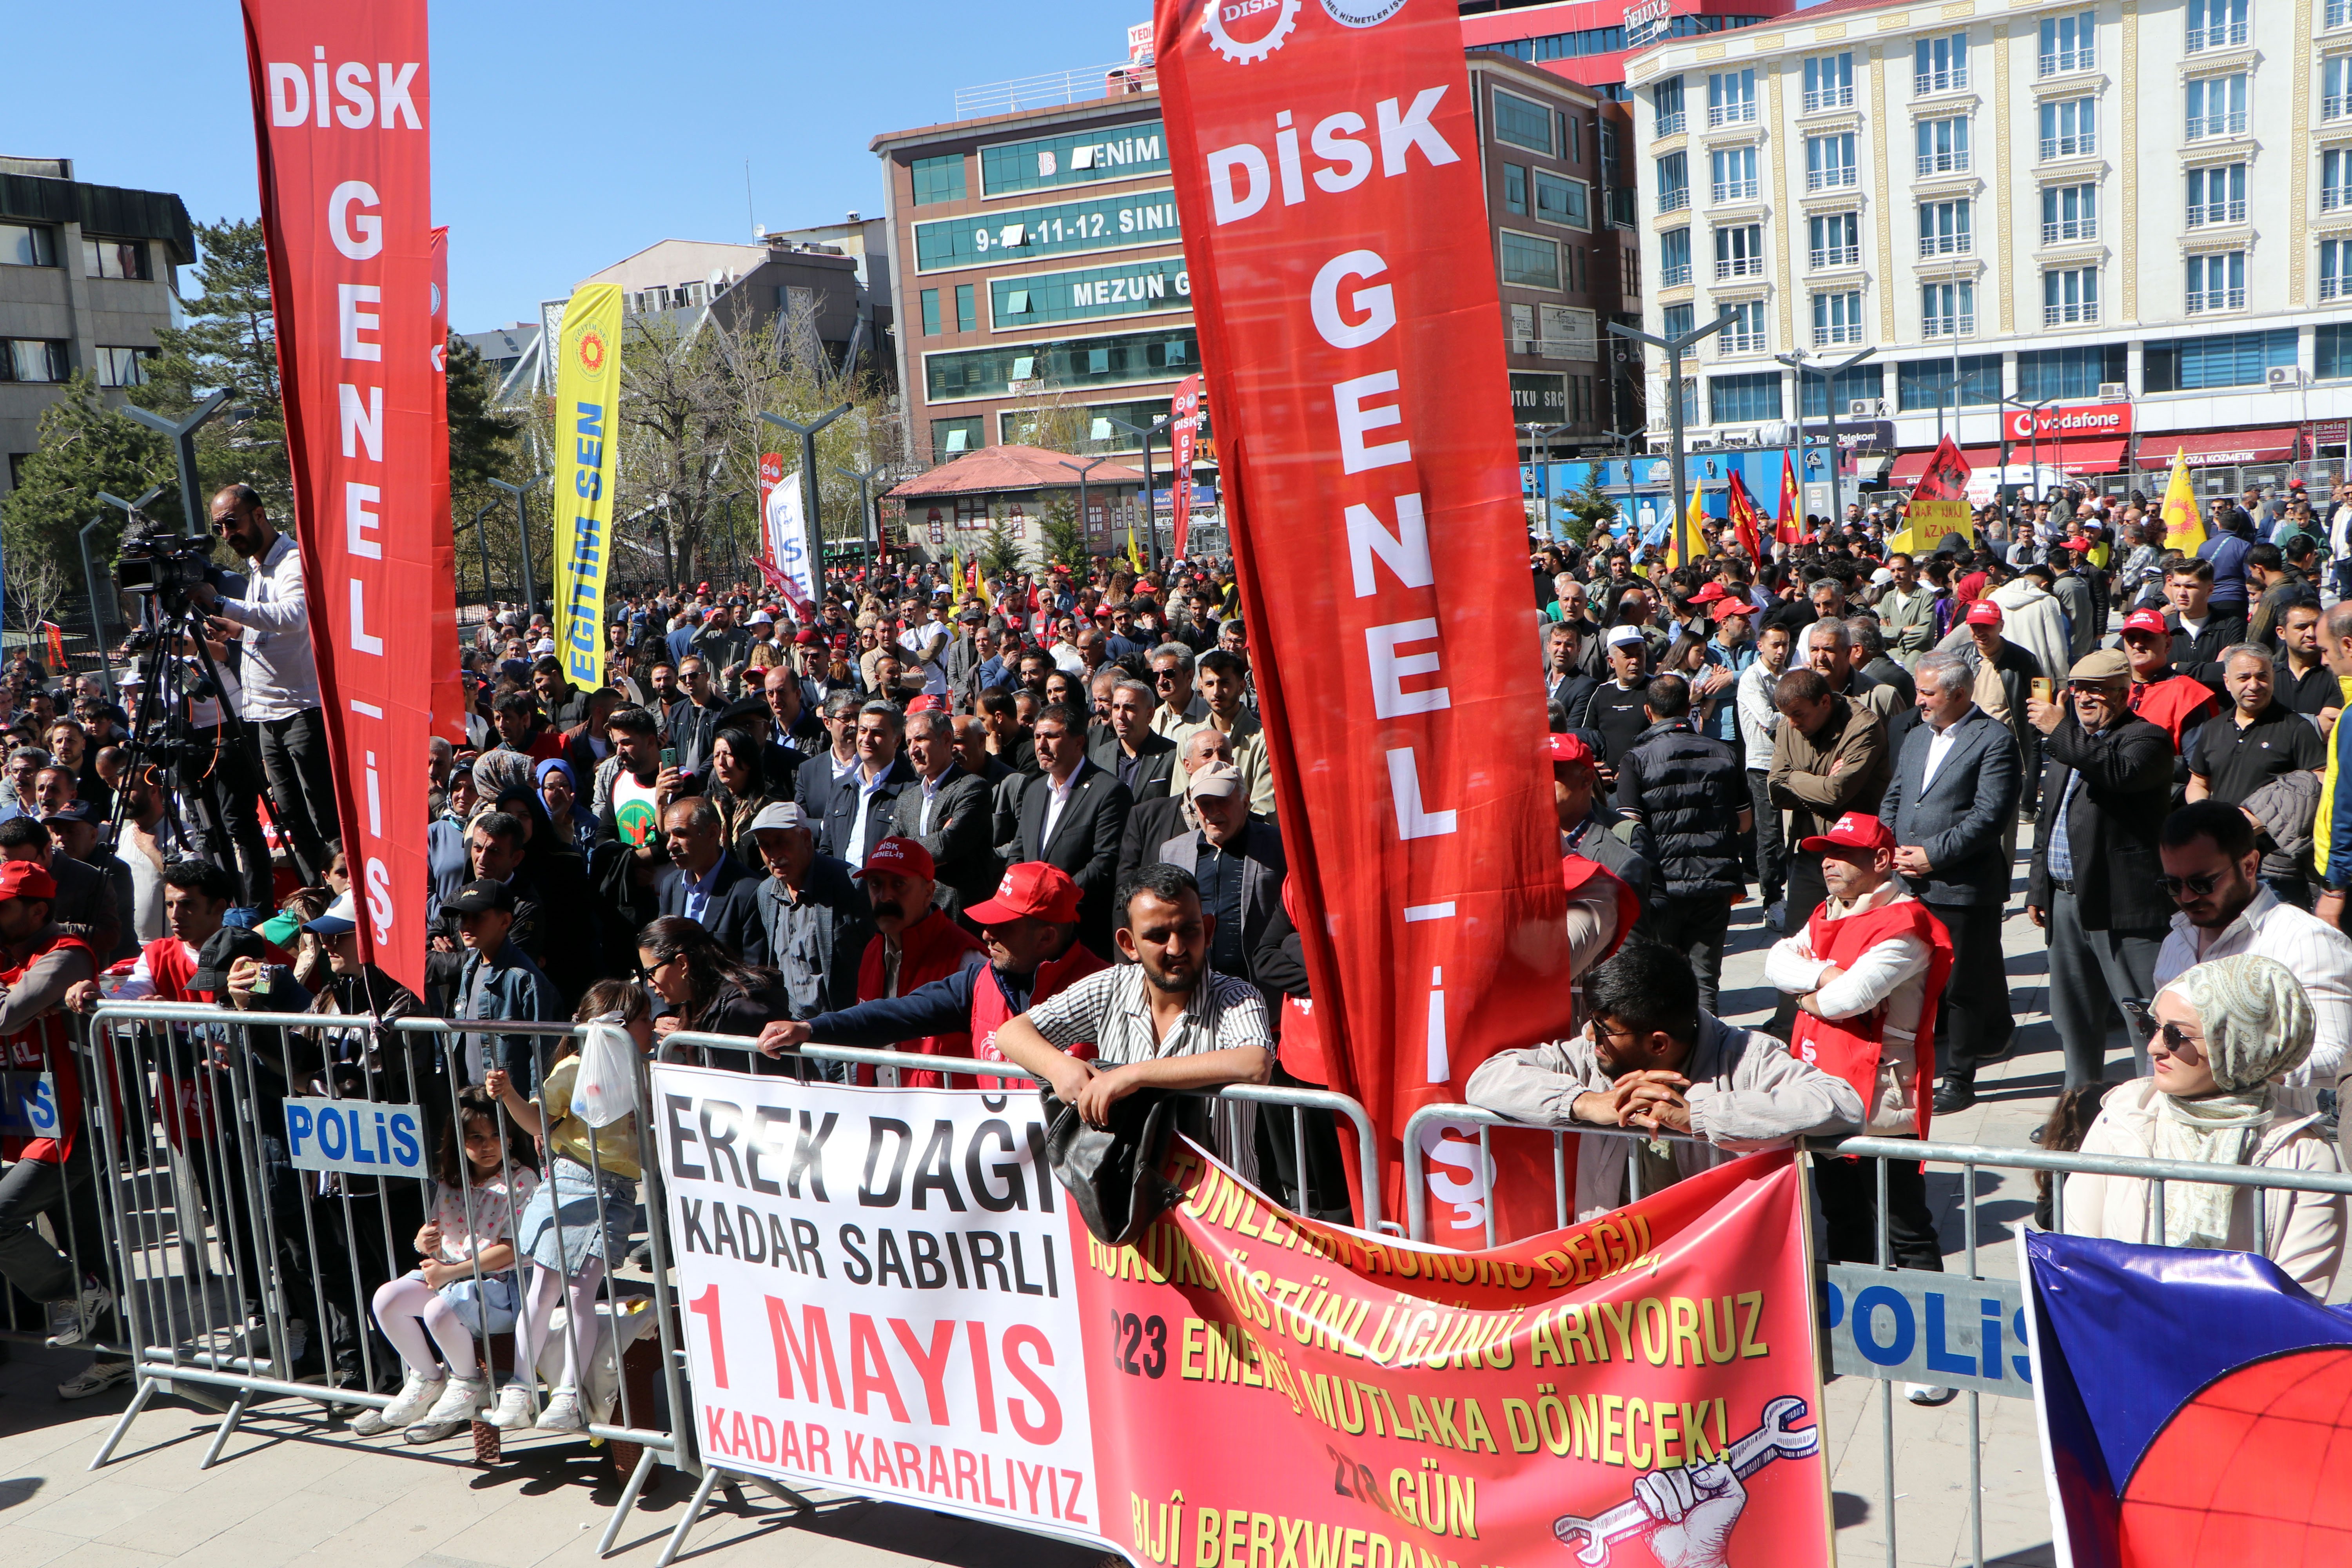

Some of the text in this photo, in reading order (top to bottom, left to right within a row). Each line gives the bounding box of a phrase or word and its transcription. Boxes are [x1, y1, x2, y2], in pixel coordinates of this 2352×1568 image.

[1339, 9, 1389, 24] HİZMETLER
[1624, 0, 1670, 33] DELUXE
[269, 45, 423, 130] DİSK
[1207, 84, 1461, 226] DİSK
[1073, 274, 1165, 307] MEZUN
[1544, 391, 1564, 407] SRC
[2040, 412, 2120, 430] vodafone
[2317, 422, 2346, 430] EMİR
[575, 401, 603, 501] SEN
[1815, 432, 1877, 443] Tür Telekom
[2206, 452, 2256, 463] KOZMETİK
[564, 516, 601, 683] EĞİTİM
[871, 851, 904, 859] GENEL-İŞ
[878, 841, 899, 851] DİSK
[287, 1105, 420, 1167] POLİS
[665, 1093, 1055, 1214] EREK DAĞI
[680, 1196, 1059, 1298] KADAR SABIRLI
[1531, 1290, 1768, 1367] ARIYORUZ
[689, 1283, 1063, 1446] 1 MAYIS
[1110, 1308, 1168, 1379] 223
[1299, 1368, 1499, 1454] MUTLAKA
[1502, 1383, 1731, 1470] DÖNECEK!
[705, 1405, 1088, 1524] KADAR KARARLIYIZ
